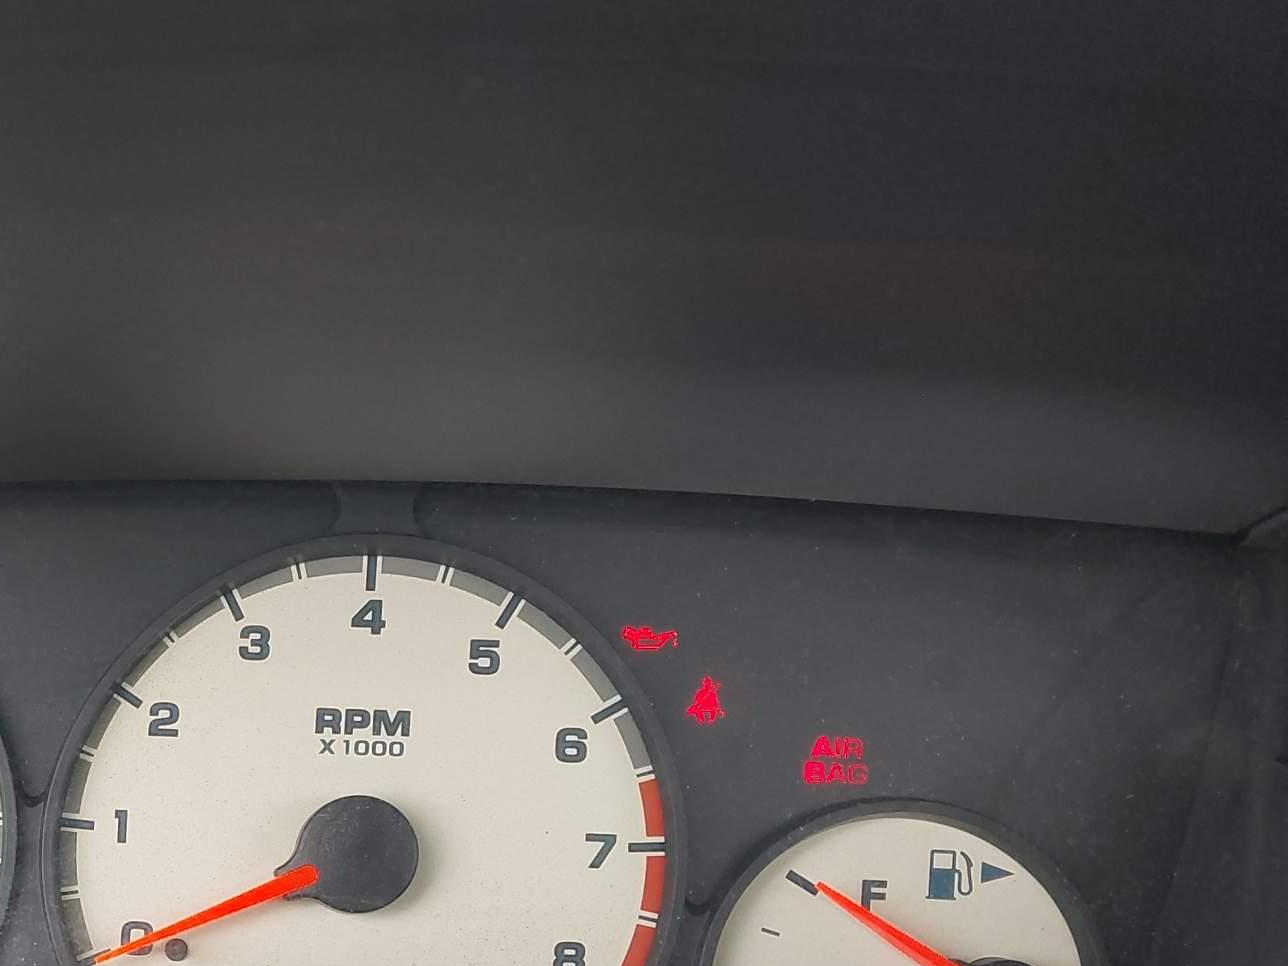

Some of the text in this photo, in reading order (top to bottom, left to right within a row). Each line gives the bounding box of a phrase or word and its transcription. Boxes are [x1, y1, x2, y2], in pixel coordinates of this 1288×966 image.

[351, 599, 386, 635] 4
[239, 626, 271, 661] 3
[468, 639, 500, 675] 5
[148, 702, 180, 737] 2
[315, 708, 410, 736] RPM
[340, 739, 404, 757] 1000
[555, 728, 587, 763] 6
[810, 735, 864, 759] AIR
[802, 760, 870, 784] BAG
[115, 810, 128, 843] 1
[585, 834, 617, 868] 7
[861, 880, 887, 912] F
[120, 920, 153, 956] 0
